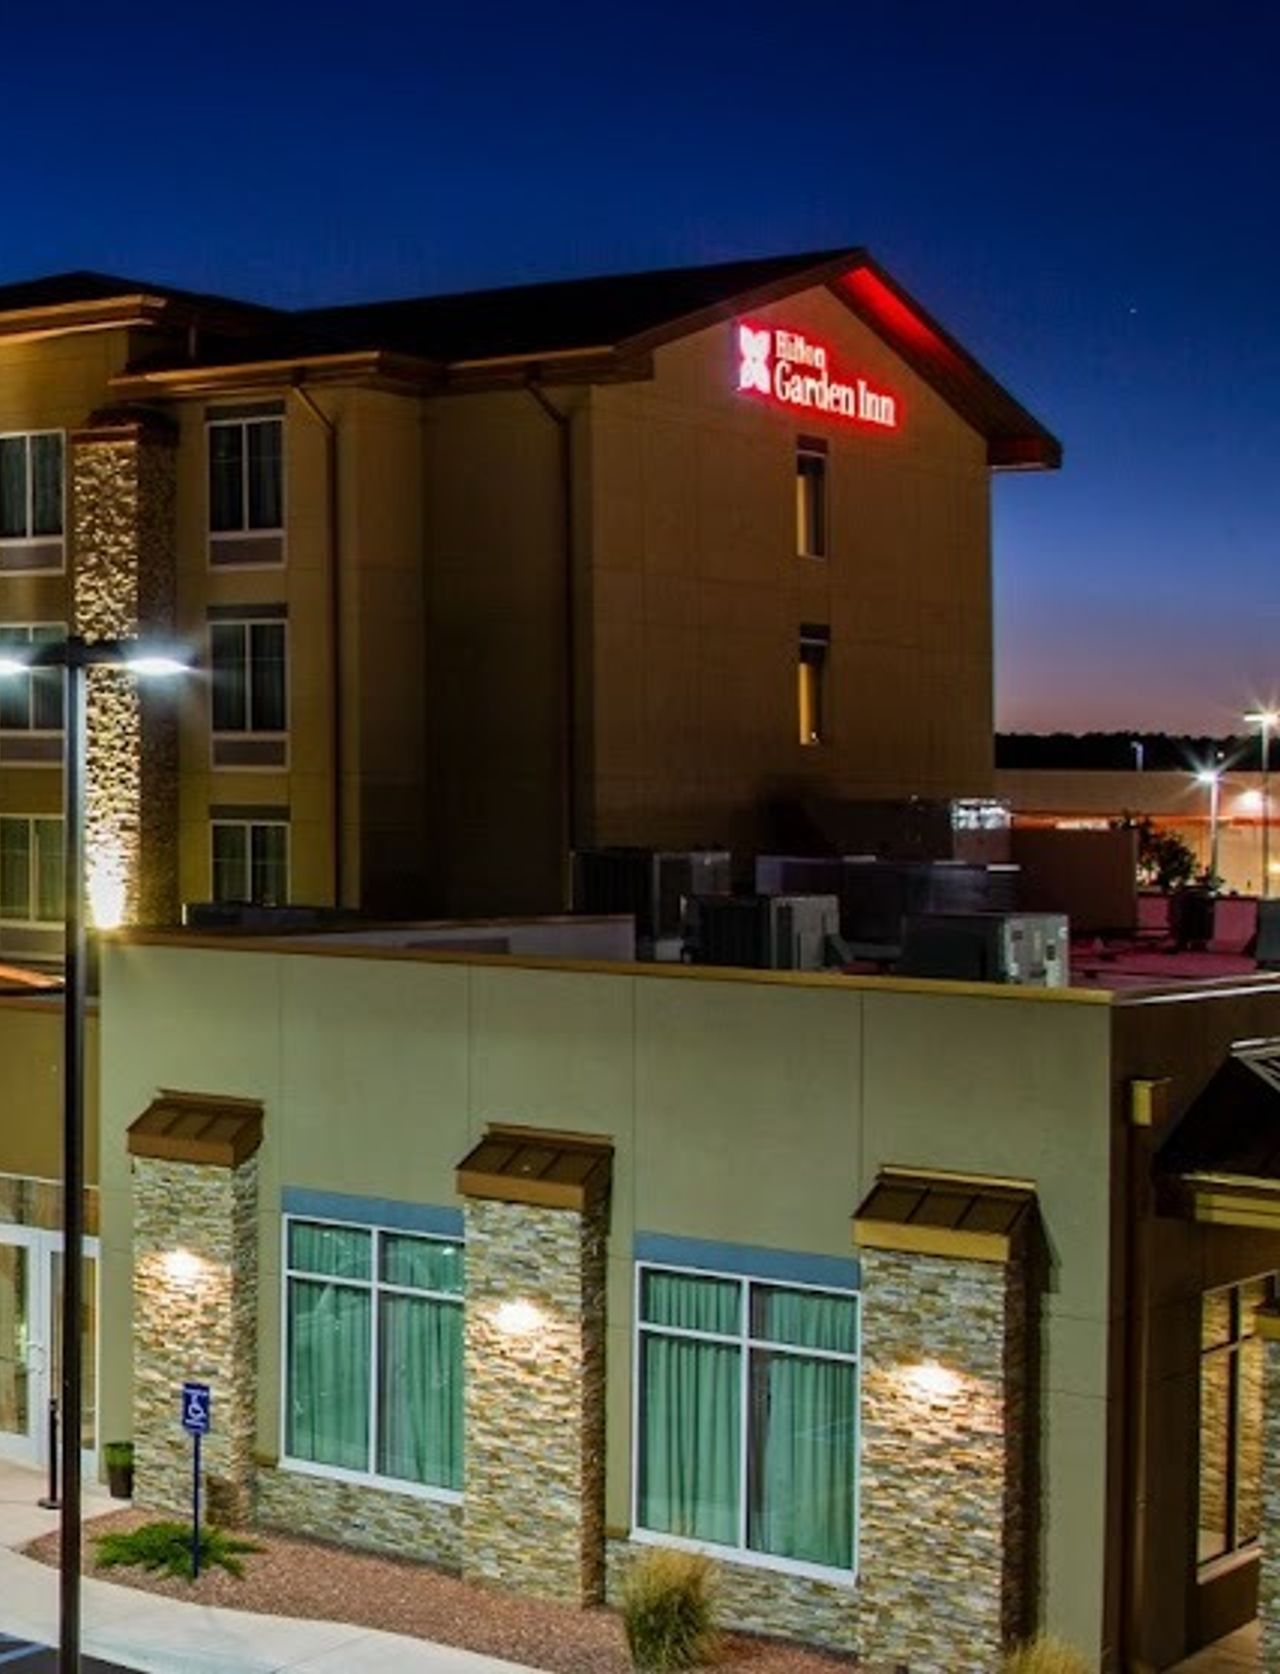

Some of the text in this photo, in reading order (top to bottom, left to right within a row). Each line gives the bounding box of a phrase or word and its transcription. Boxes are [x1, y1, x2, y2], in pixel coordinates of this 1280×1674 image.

[776, 330, 826, 369] Hilton
[774, 360, 897, 427] Garden Inn
